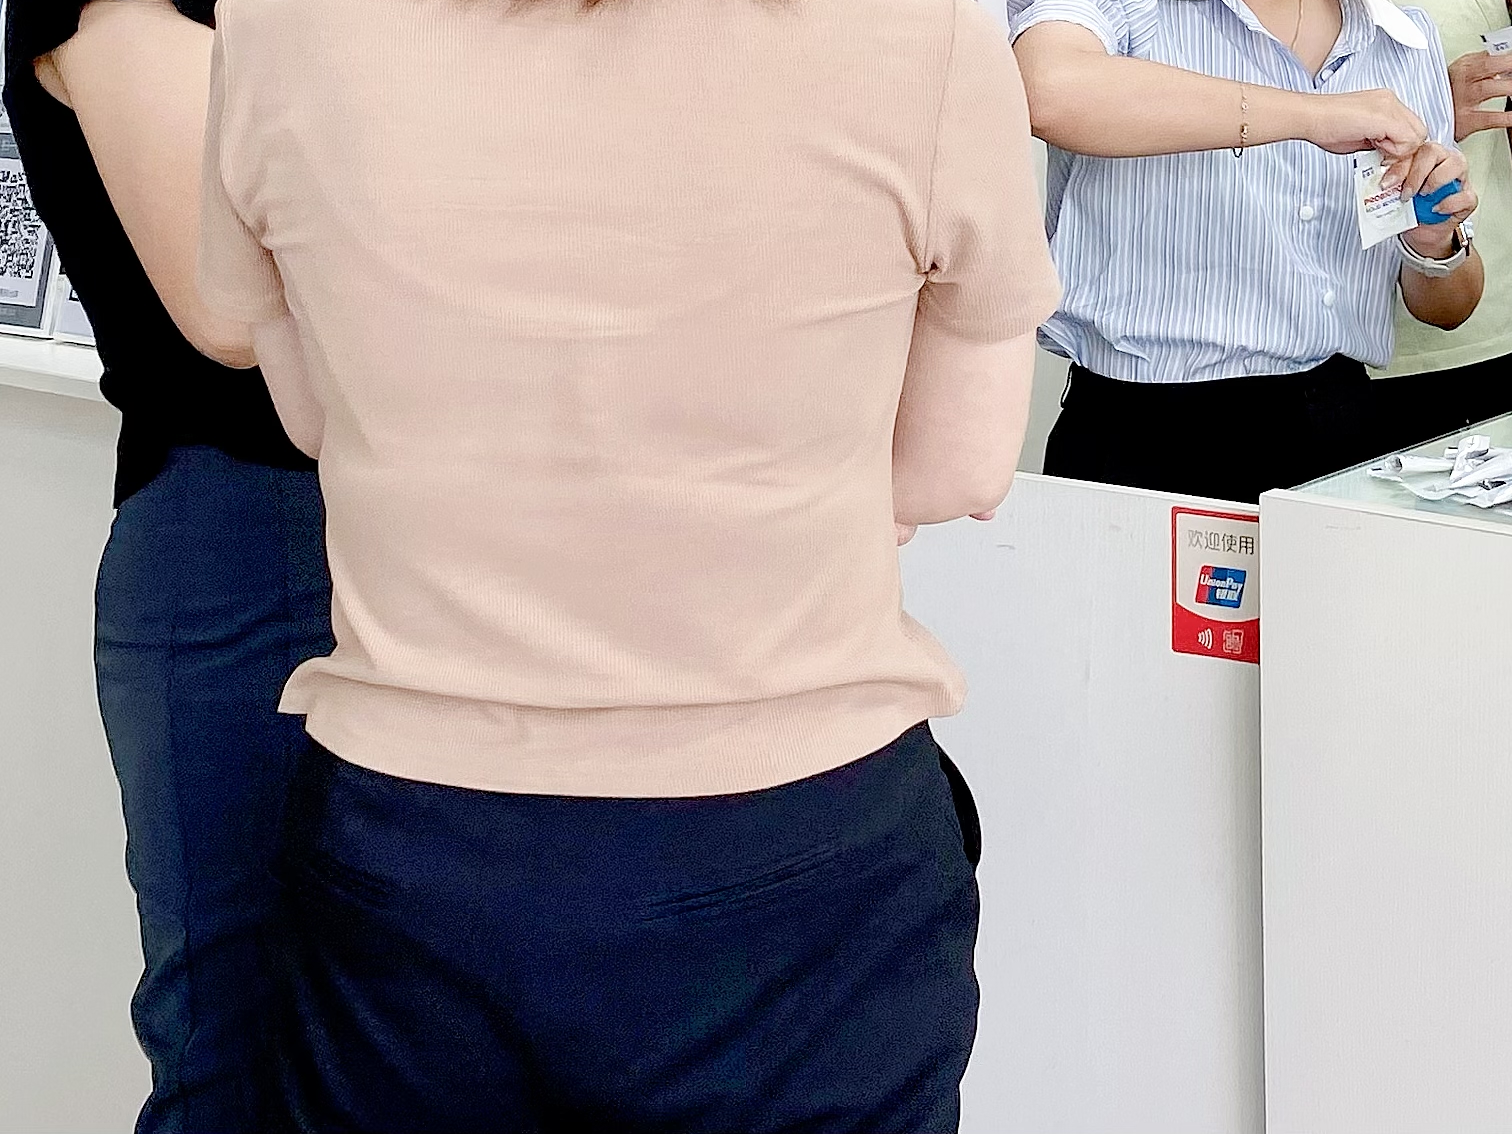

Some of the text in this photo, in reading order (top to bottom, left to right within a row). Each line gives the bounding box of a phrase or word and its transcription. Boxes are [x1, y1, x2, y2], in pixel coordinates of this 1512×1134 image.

[1188, 529, 1254, 555] 欢迎使用
[1200, 573, 1243, 593] UnionPay
[1215, 588, 1241, 601] 银联
